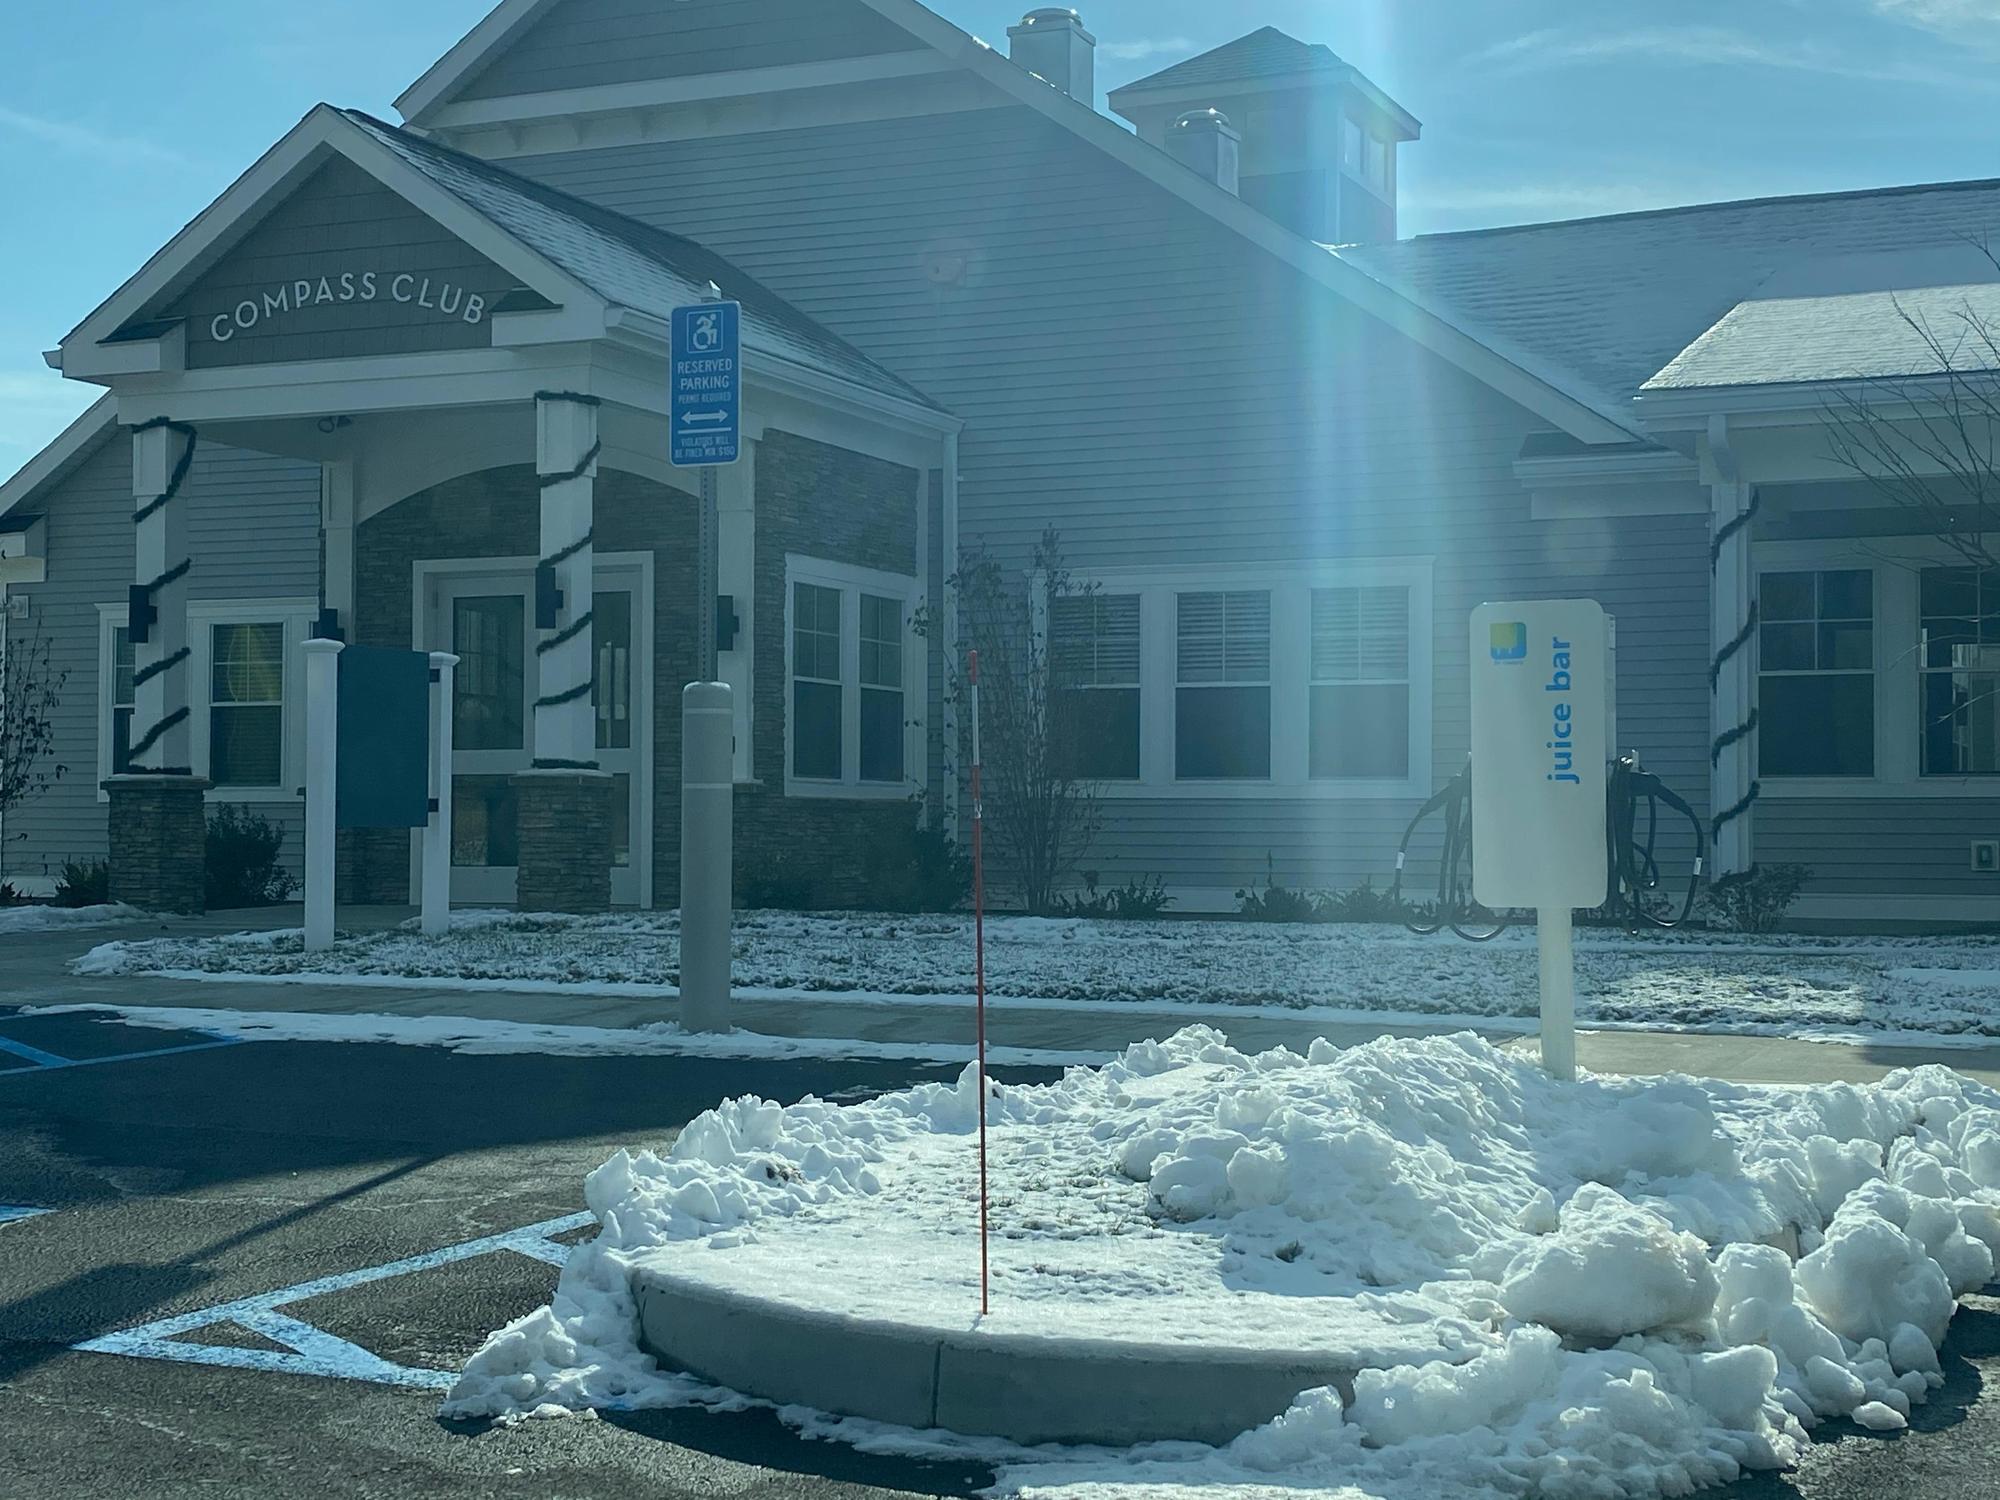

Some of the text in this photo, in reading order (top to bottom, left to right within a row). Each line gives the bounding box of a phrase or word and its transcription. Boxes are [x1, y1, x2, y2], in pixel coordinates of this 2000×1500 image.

[210, 272, 485, 341] COMPASS CLUB
[677, 358, 732, 374] RESERVED
[680, 375, 729, 390] PARKING
[1545, 636, 1580, 785] juice bar
